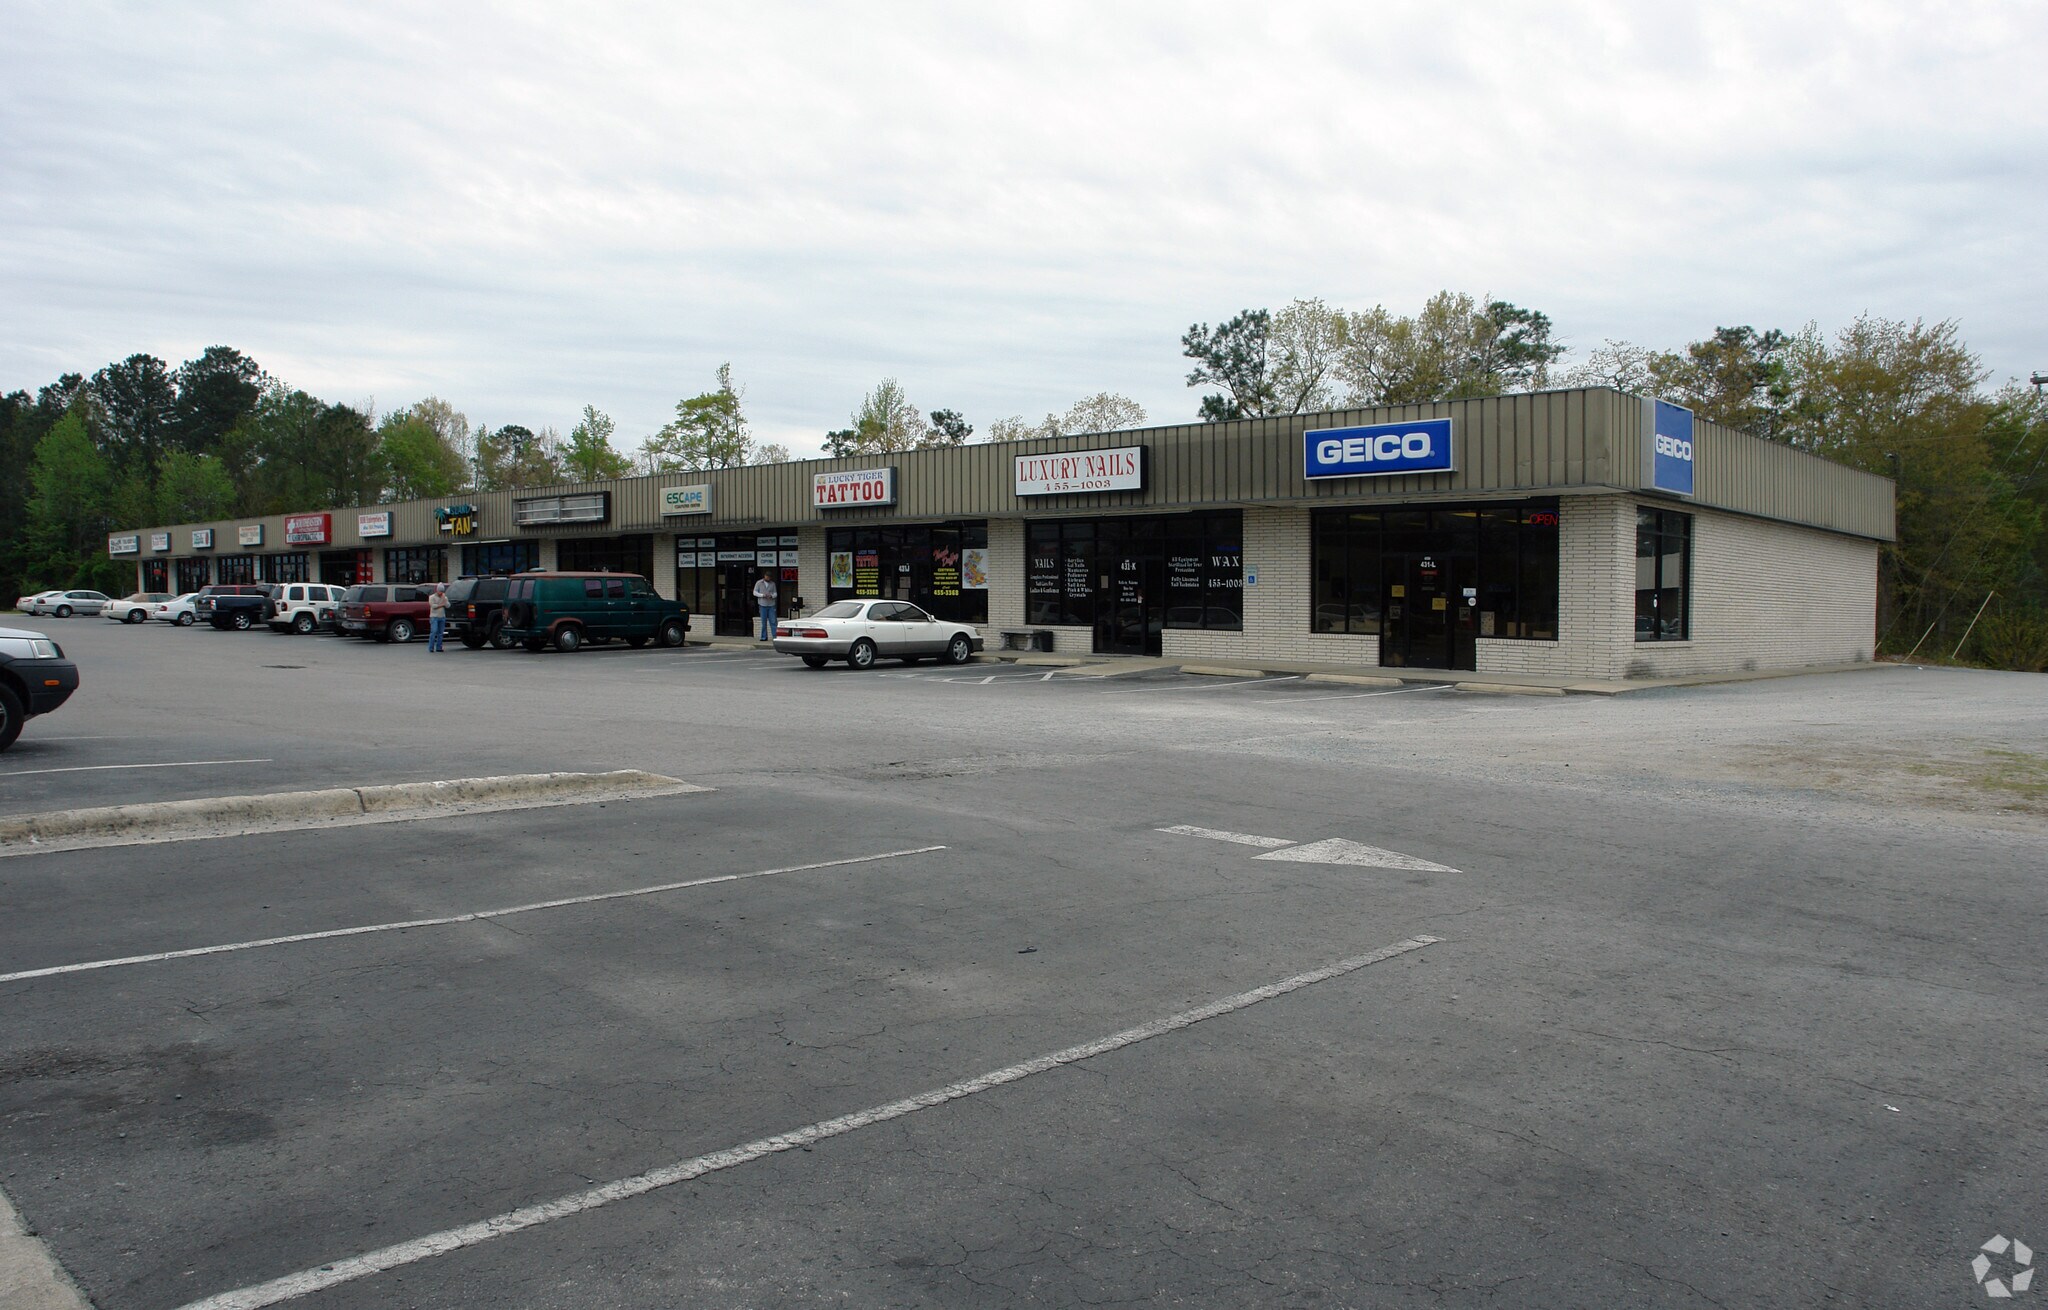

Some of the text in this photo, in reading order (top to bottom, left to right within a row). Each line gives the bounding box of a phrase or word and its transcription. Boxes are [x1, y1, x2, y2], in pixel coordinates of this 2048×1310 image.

[1317, 432, 1431, 464] GEICO
[1655, 433, 1692, 461] GEICO
[1020, 452, 1135, 482] LUXURY NAILS
[828, 471, 883, 483] LUCKY TIGER
[666, 491, 702, 504] ESCAPE
[816, 480, 884, 503] TATTOO
[449, 516, 471, 535] TAN
[1529, 513, 1559, 526] OPEN
[1034, 558, 1055, 569] NAILS
[1121, 562, 1136, 570] 431-K
[1211, 555, 1240, 567] WAX
[1207, 578, 1243, 588] 455-1003
